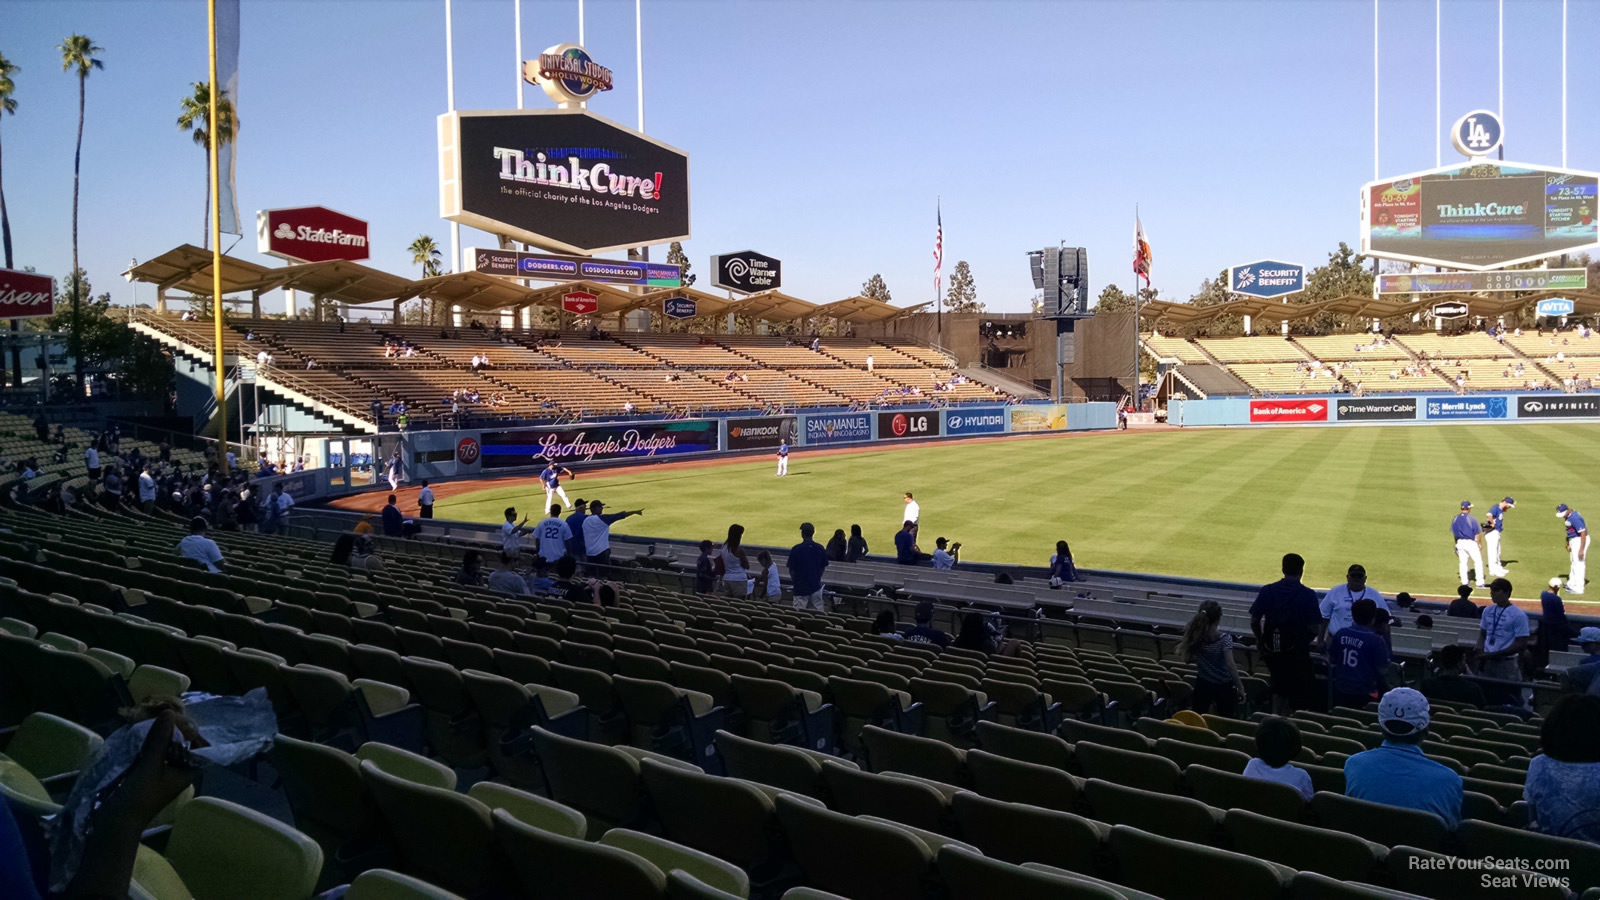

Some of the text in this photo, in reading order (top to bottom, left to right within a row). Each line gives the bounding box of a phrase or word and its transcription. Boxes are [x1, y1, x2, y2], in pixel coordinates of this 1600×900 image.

[541, 55, 613, 84] UNIVERSAL STUDIOS
[552, 72, 605, 88] HOLLYWOOD
[1467, 118, 1490, 147] LA
[493, 146, 663, 200] ThinkCure!
[1558, 186, 1586, 196] 73-57
[500, 186, 513, 195] the
[515, 188, 542, 198] official
[543, 192, 569, 204] charity
[579, 196, 591, 206] the
[592, 198, 604, 207] Los
[605, 200, 632, 212] Angeles
[632, 204, 660, 215] Dodgers
[1437, 201, 1529, 217] ThinkCure!
[491, 255, 516, 264] SECURITY
[749, 259, 769, 268] Time
[527, 262, 575, 272] DODGERS.COM
[585, 266, 639, 276] LOSDODGERS.COM
[749, 267, 776, 277] Warner
[1259, 269, 1299, 277] SECURITY
[1550, 274, 1584, 283] SUBWAY
[749, 276, 772, 285] Cable
[1259, 278, 1297, 286] BENEFIT
[1279, 407, 1306, 415] America
[1349, 404, 1413, 413] Time Warner Cable
[1442, 402, 1465, 410] Merrill
[1466, 402, 1486, 411] Lynch
[807, 417, 869, 432] SAN MANUEL
[910, 416, 928, 432] LG
[965, 415, 1004, 426] HYUNDAI
[460, 442, 477, 459] 76
[532, 429, 676, 462] Los Angeles Dodgers
[545, 527, 559, 539] 22
[1340, 635, 1364, 648] ETHIER
[1342, 648, 1359, 667] 16
